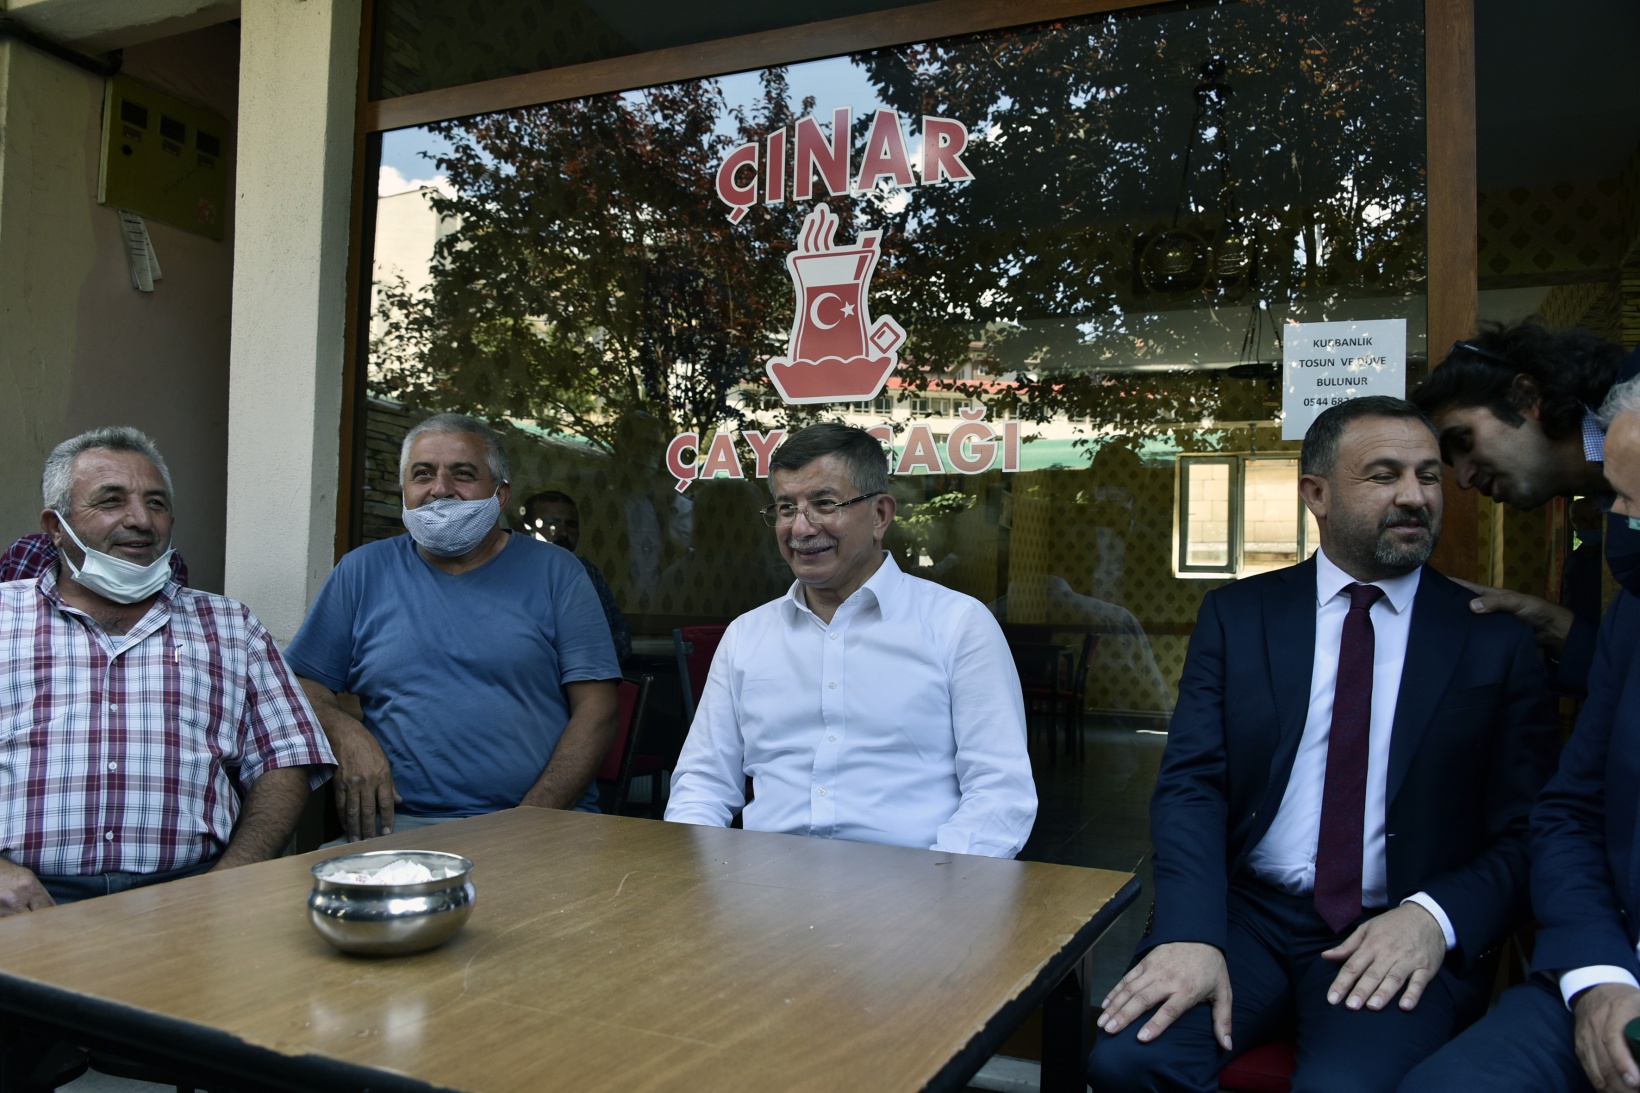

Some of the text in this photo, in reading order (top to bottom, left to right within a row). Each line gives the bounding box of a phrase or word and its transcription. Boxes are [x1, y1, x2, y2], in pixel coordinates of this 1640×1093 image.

[715, 105, 975, 225] ÇINAR
[1299, 354, 1386, 368] TOSUN VE DÜVE
[1316, 377, 1368, 387] BULUNUR
[1303, 397, 1329, 407] 0544
[666, 407, 1021, 493] ÇAY AĞI
